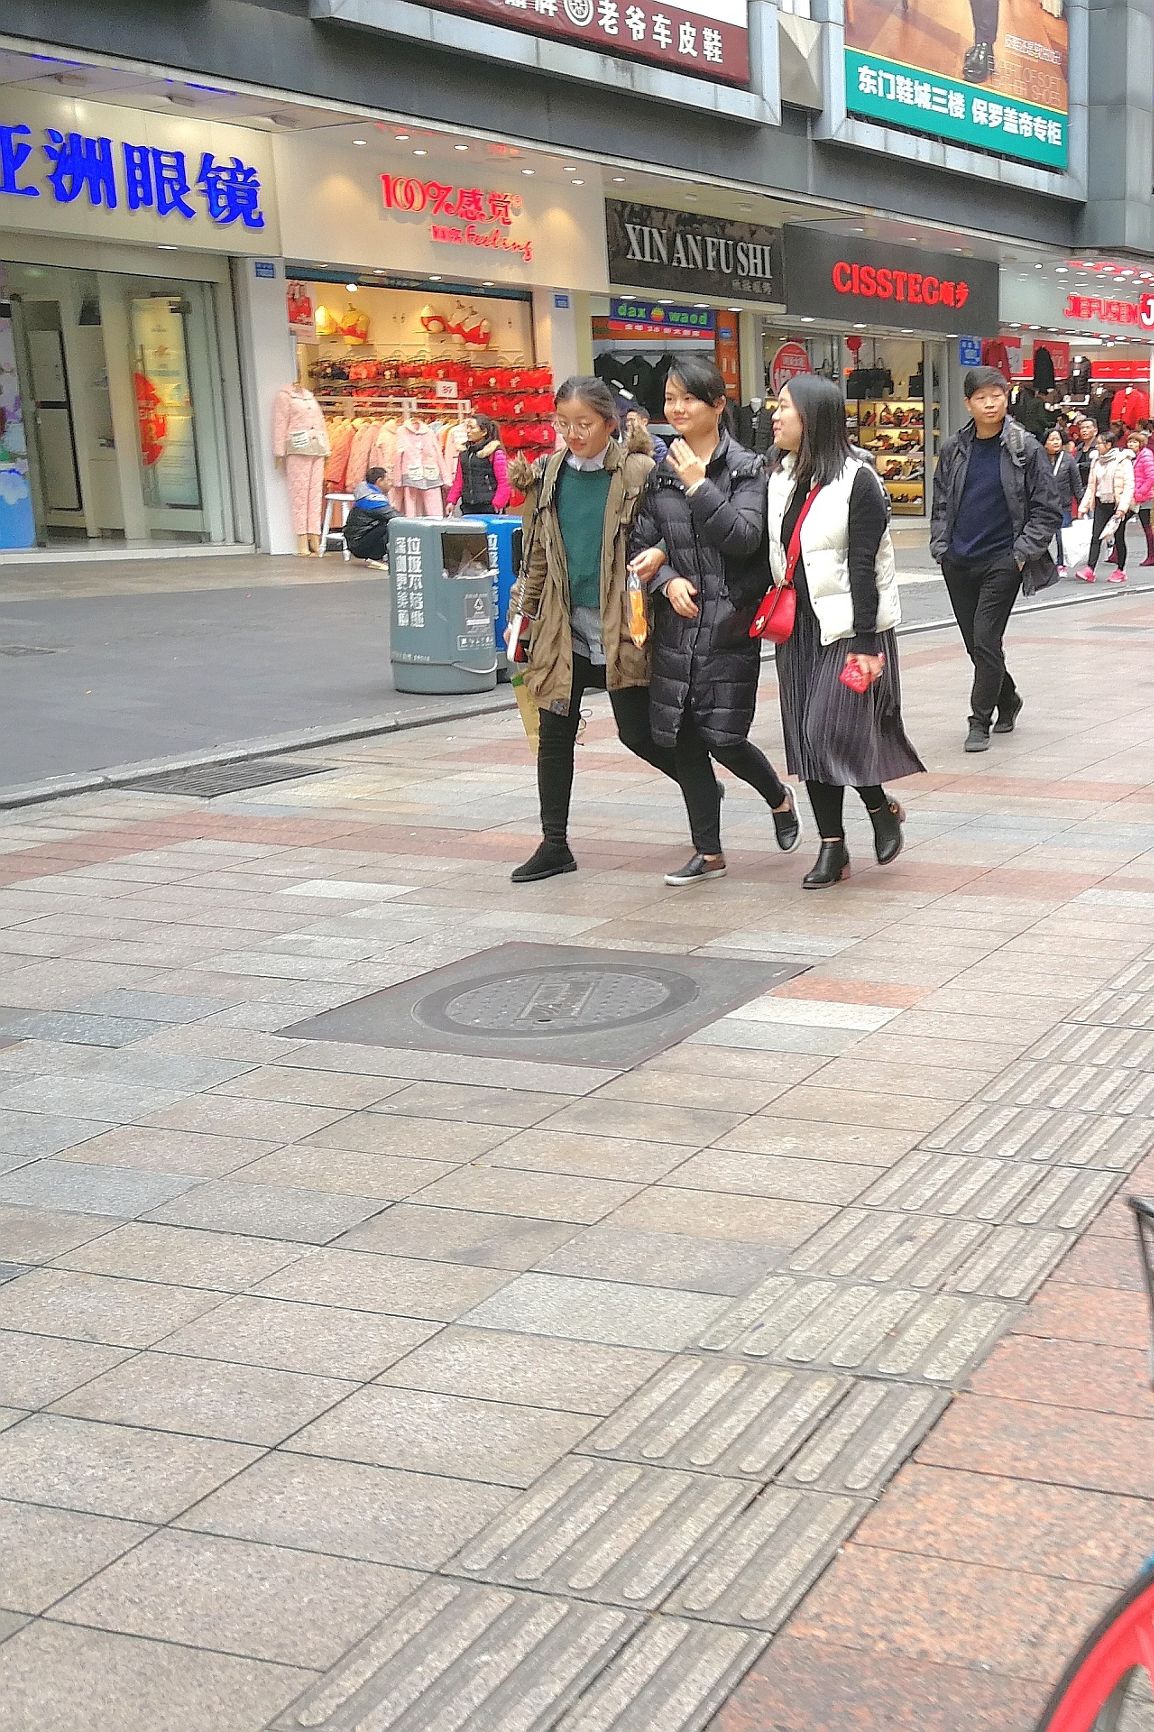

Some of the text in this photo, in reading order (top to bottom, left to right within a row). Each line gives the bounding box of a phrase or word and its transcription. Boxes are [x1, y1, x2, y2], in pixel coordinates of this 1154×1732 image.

[597, 0, 723, 63] 老爷车皮鞋
[857, 64, 965, 120] 东门鞋城三楼
[971, 97, 1063, 146] 保罗盖帝专柜
[0, 124, 265, 228] 亚洲眼镜
